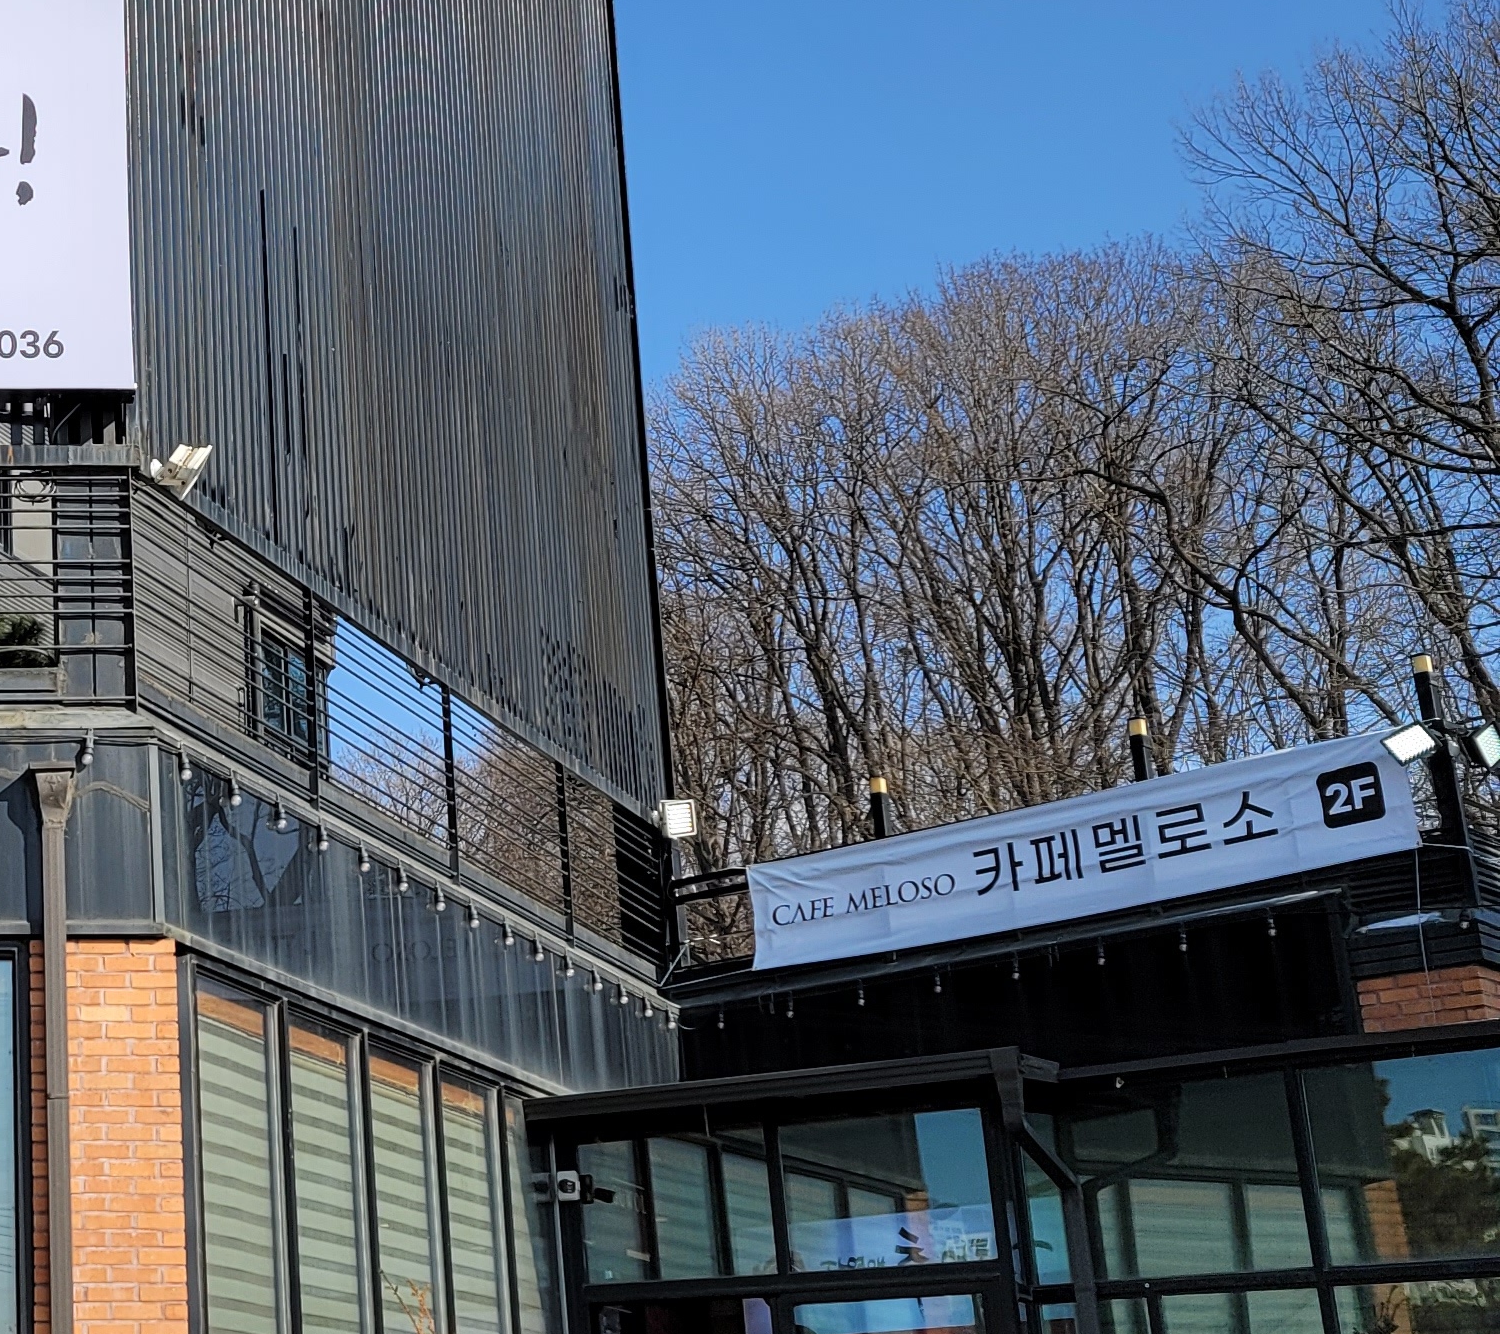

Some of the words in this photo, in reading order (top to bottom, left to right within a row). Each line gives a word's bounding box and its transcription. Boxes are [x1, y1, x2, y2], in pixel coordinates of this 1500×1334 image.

[772, 896, 835, 927] CAFE
[846, 873, 956, 916] MELOSO
[973, 790, 1280, 897] 카페멜로소
[1325, 775, 1378, 815] 2F
